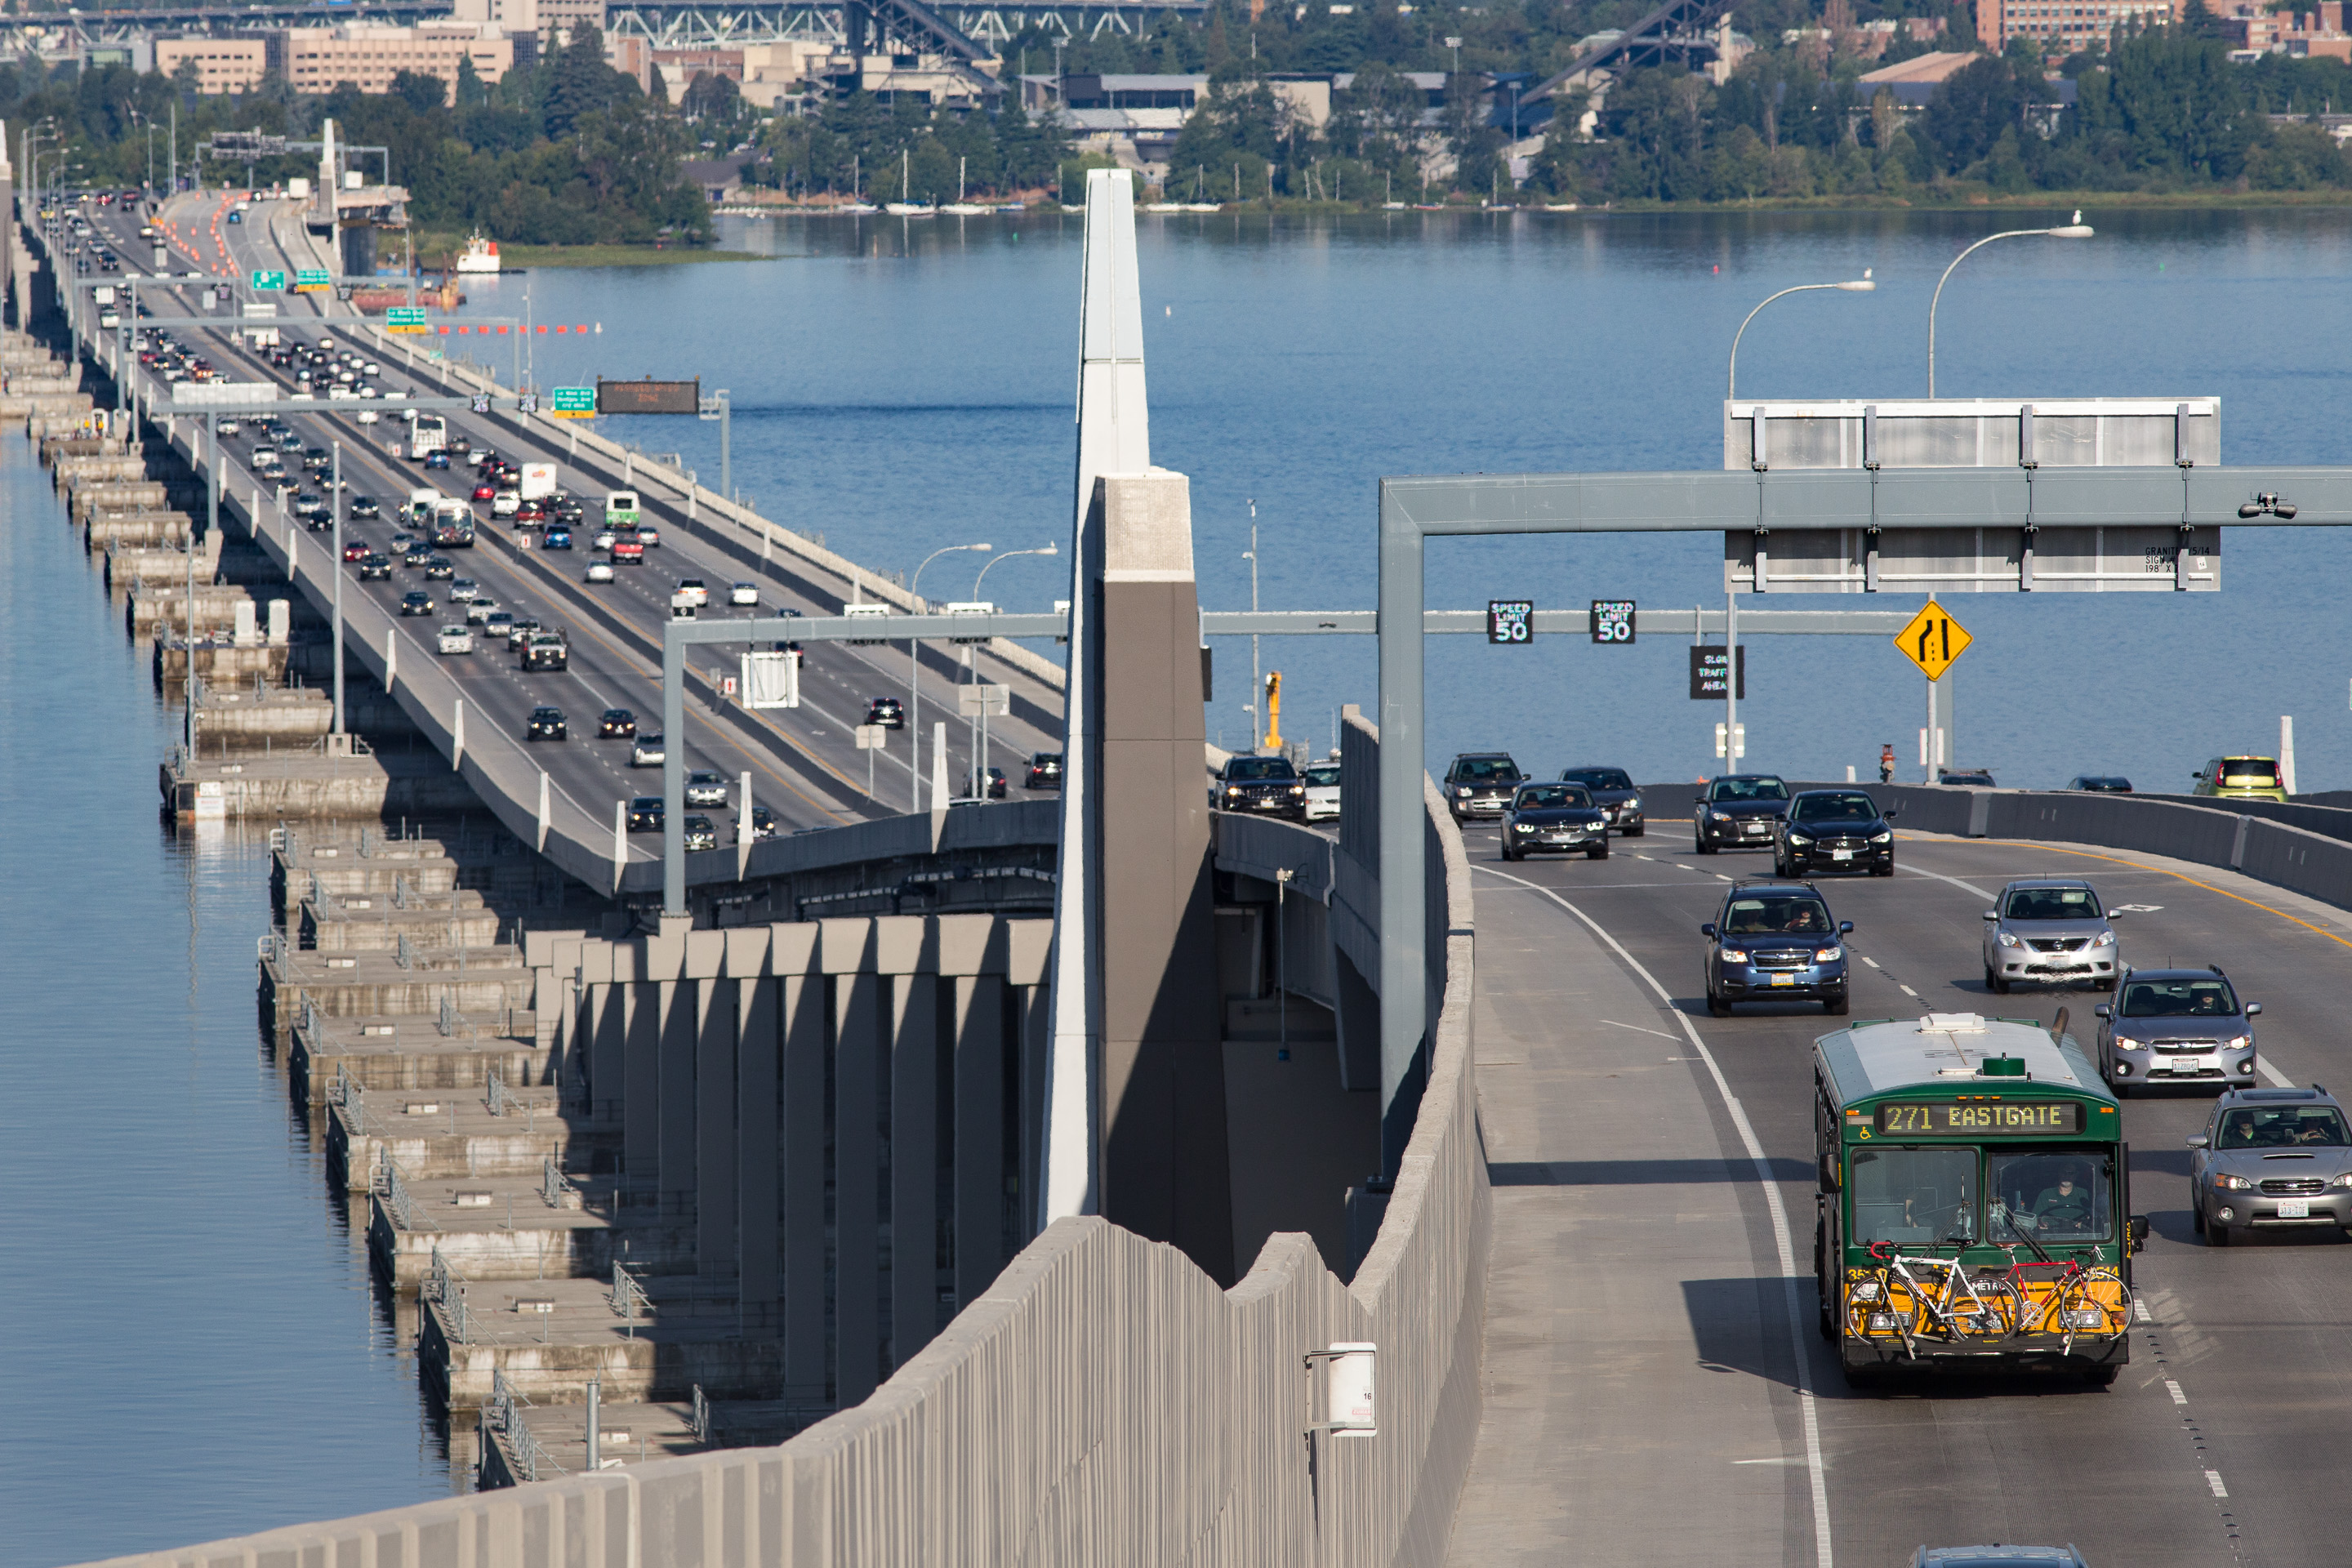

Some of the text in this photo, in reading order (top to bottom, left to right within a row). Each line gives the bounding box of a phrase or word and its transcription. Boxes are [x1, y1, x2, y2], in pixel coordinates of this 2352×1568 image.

[2189, 546, 2210, 555] /5/14
[2145, 555, 2165, 564] SIGN
[2166, 564, 2172, 573] X
[1491, 603, 1531, 612] SPEED
[1594, 602, 1634, 612] SPEED
[1495, 612, 1526, 622] LIMIT
[1598, 612, 1629, 622] LIMIT
[1494, 621, 1528, 641] 50
[1597, 621, 1631, 641] 50
[1699, 667, 1727, 678] TRAFF
[1701, 680, 1727, 691] AHEA
[1887, 1106, 2062, 1129] 271 EASTGATE
